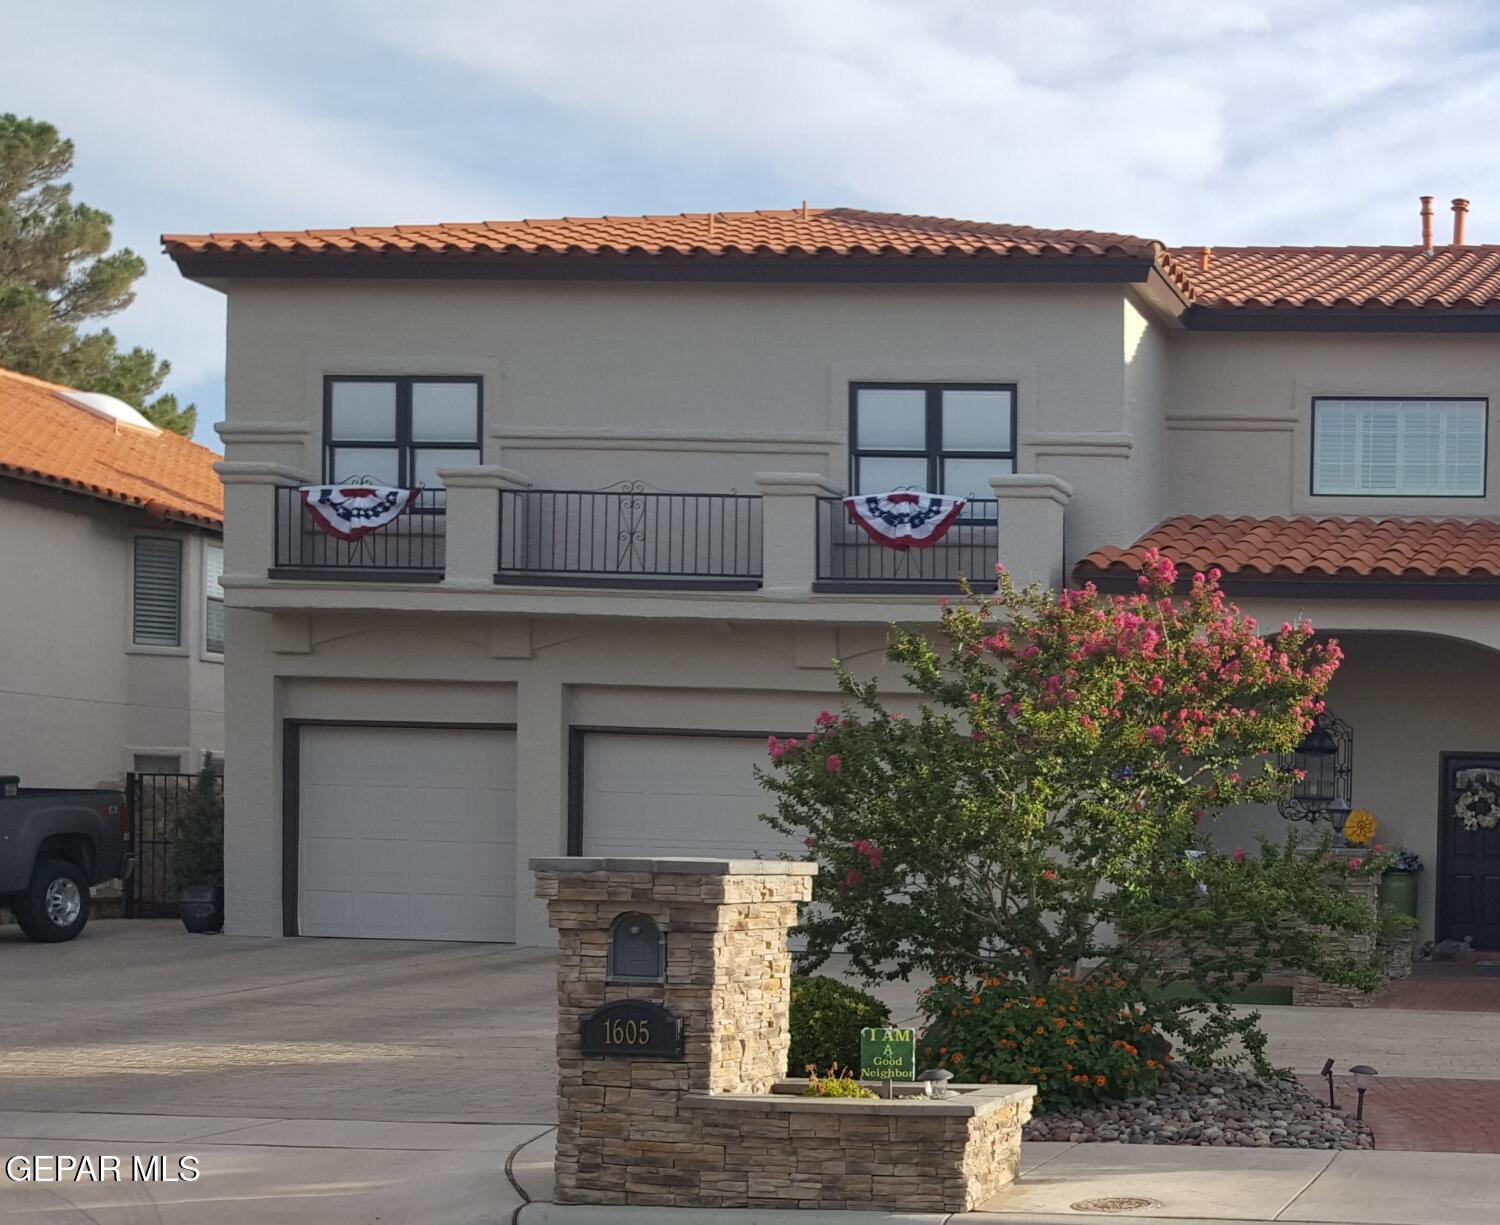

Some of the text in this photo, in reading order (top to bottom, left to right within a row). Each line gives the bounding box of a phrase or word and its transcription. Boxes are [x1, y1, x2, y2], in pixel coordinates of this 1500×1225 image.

[603, 1019, 649, 1045] 1605
[870, 1028, 910, 1042] I AM
[883, 1044, 893, 1055] A
[873, 1056, 903, 1066] Good
[862, 1068, 913, 1079] Neighbor
